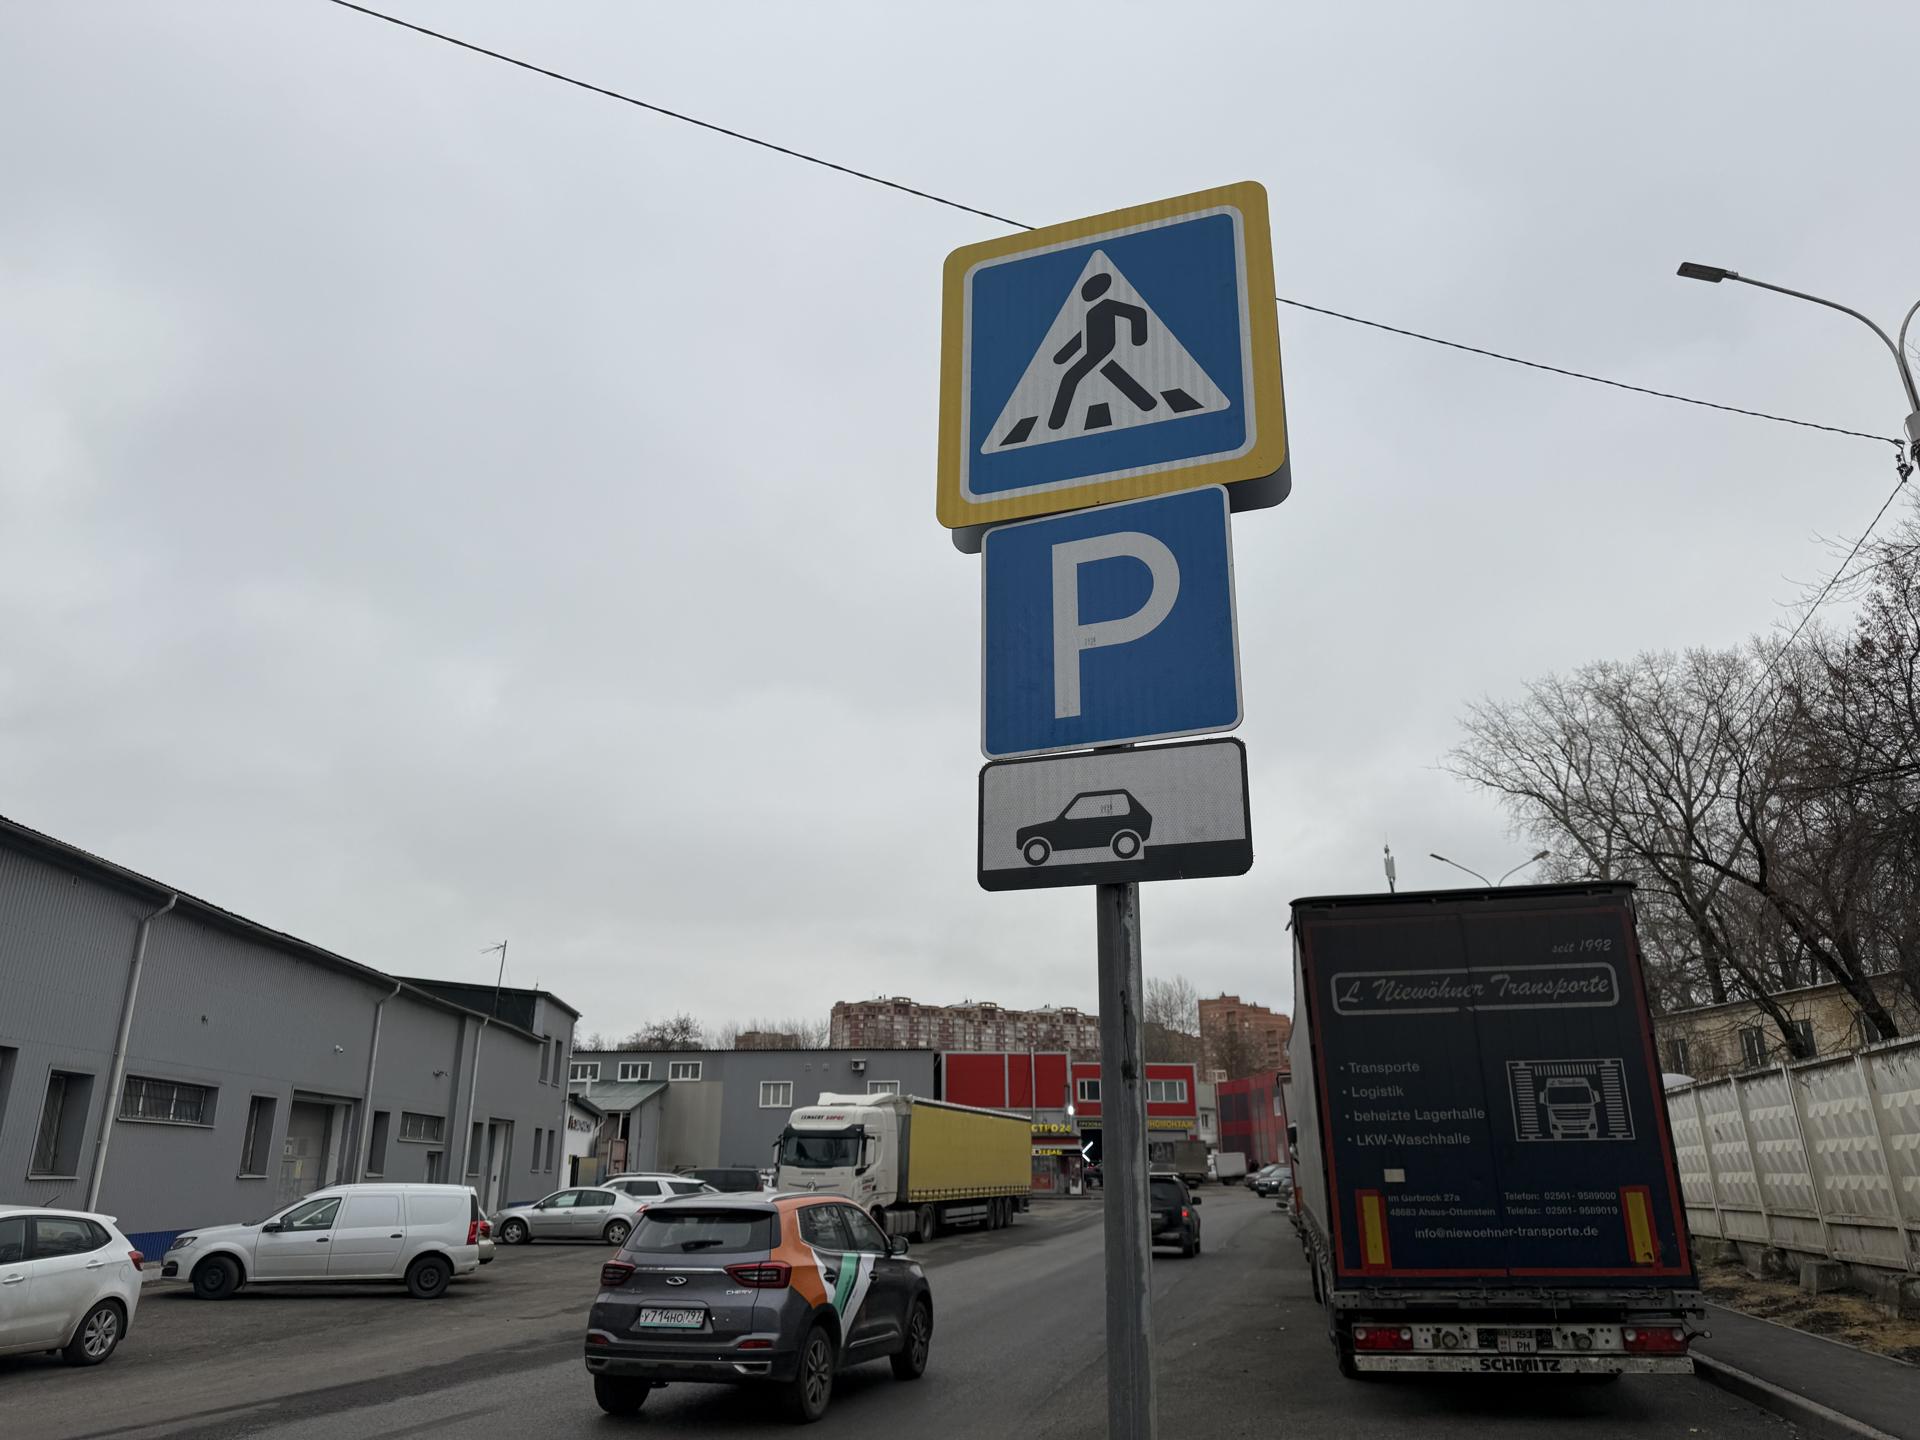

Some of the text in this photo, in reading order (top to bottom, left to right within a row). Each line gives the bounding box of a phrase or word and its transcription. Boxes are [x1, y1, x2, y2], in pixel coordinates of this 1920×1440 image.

[1052, 531, 1181, 719] P
[1579, 938, 1612, 951] 1992
[1339, 973, 1611, 1003] L. Niewöhner Transporte
[1348, 1062, 1420, 1075] Transporte
[1351, 1085, 1404, 1100] Logistik
[1354, 1107, 1486, 1123] beheizte Lagerhalle
[1356, 1132, 1472, 1146] LKW-Waschhalle
[1480, 1358, 1561, 1372] SCHMITZ
